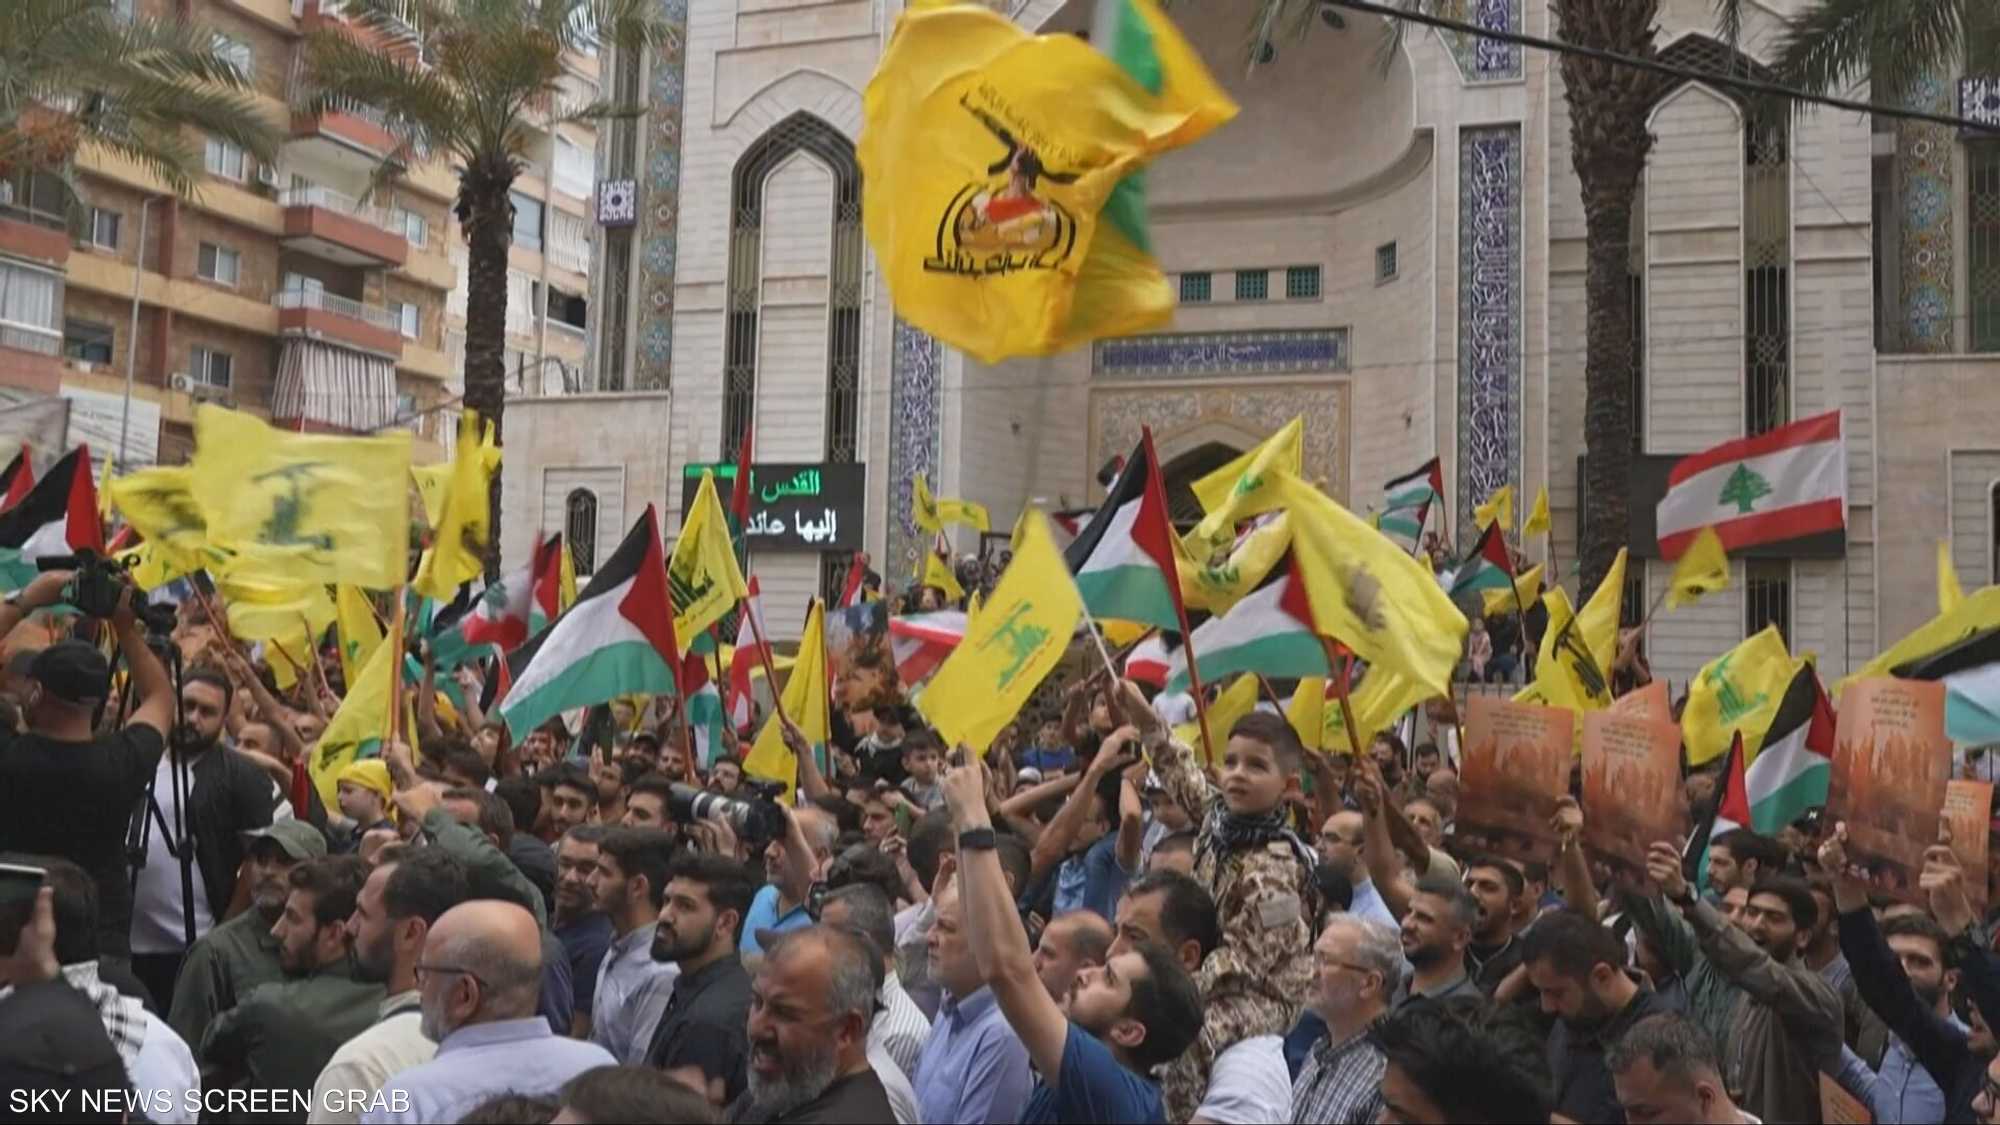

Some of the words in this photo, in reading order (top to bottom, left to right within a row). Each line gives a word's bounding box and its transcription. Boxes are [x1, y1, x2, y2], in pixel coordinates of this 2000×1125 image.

[761, 468, 820, 502] القدس
[745, 508, 786, 535] عائد
[794, 507, 837, 543] إليها
